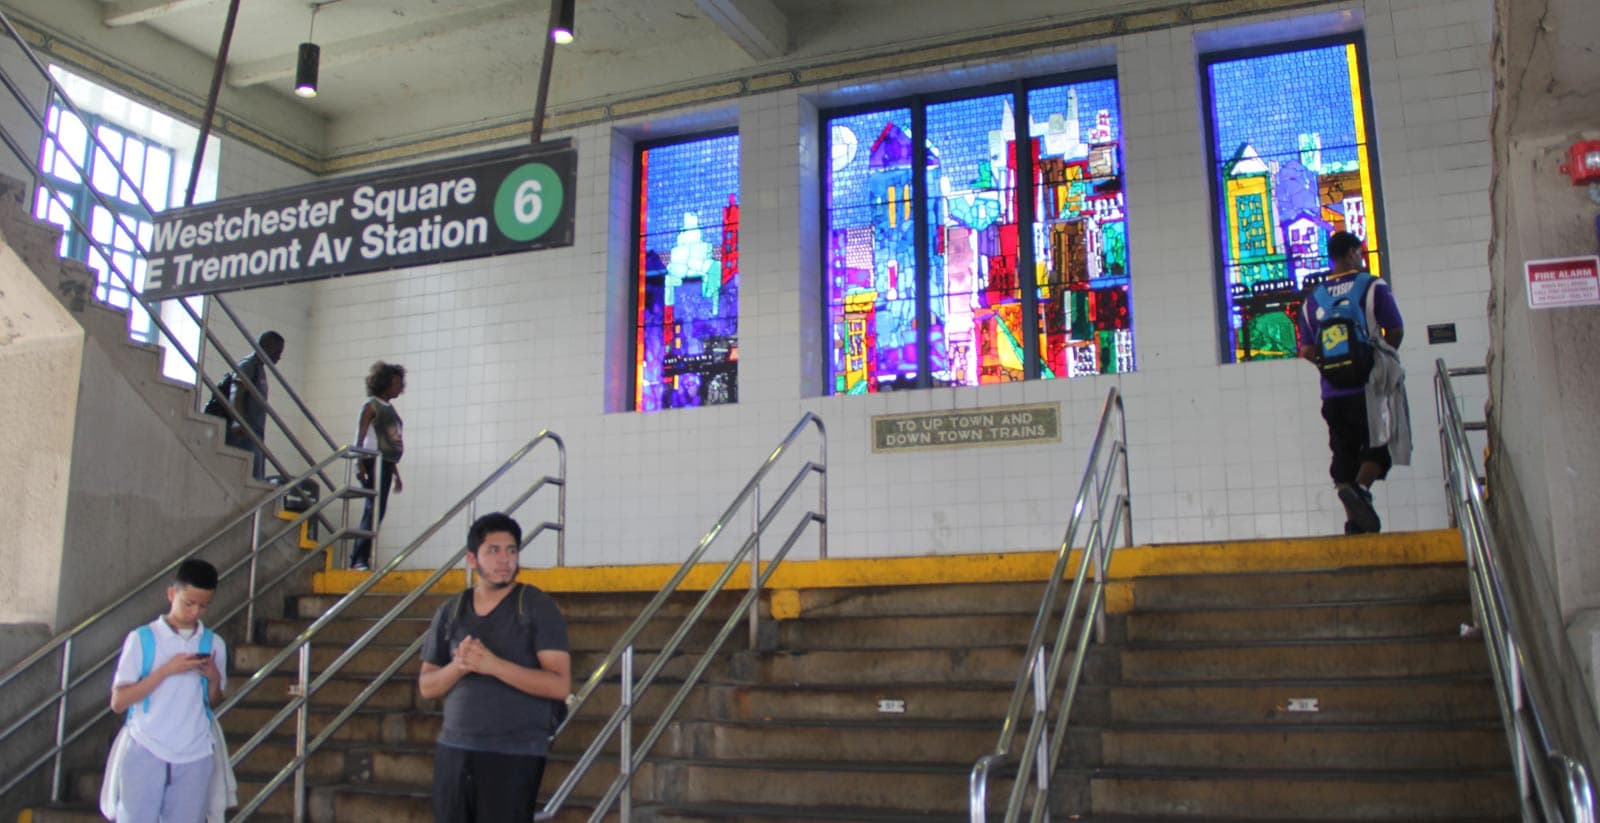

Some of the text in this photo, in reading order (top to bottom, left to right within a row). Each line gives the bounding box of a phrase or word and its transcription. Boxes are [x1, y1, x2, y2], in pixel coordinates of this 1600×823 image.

[152, 176, 477, 252] Westchester Square
[513, 179, 543, 224] 6
[144, 216, 488, 290] E Tremont Av Station
[1534, 268, 1592, 281] FIRE ALARM
[887, 425, 1045, 445] DOWN TOWN TRAINS
[897, 413, 1033, 431] TO UP TOWN AND
